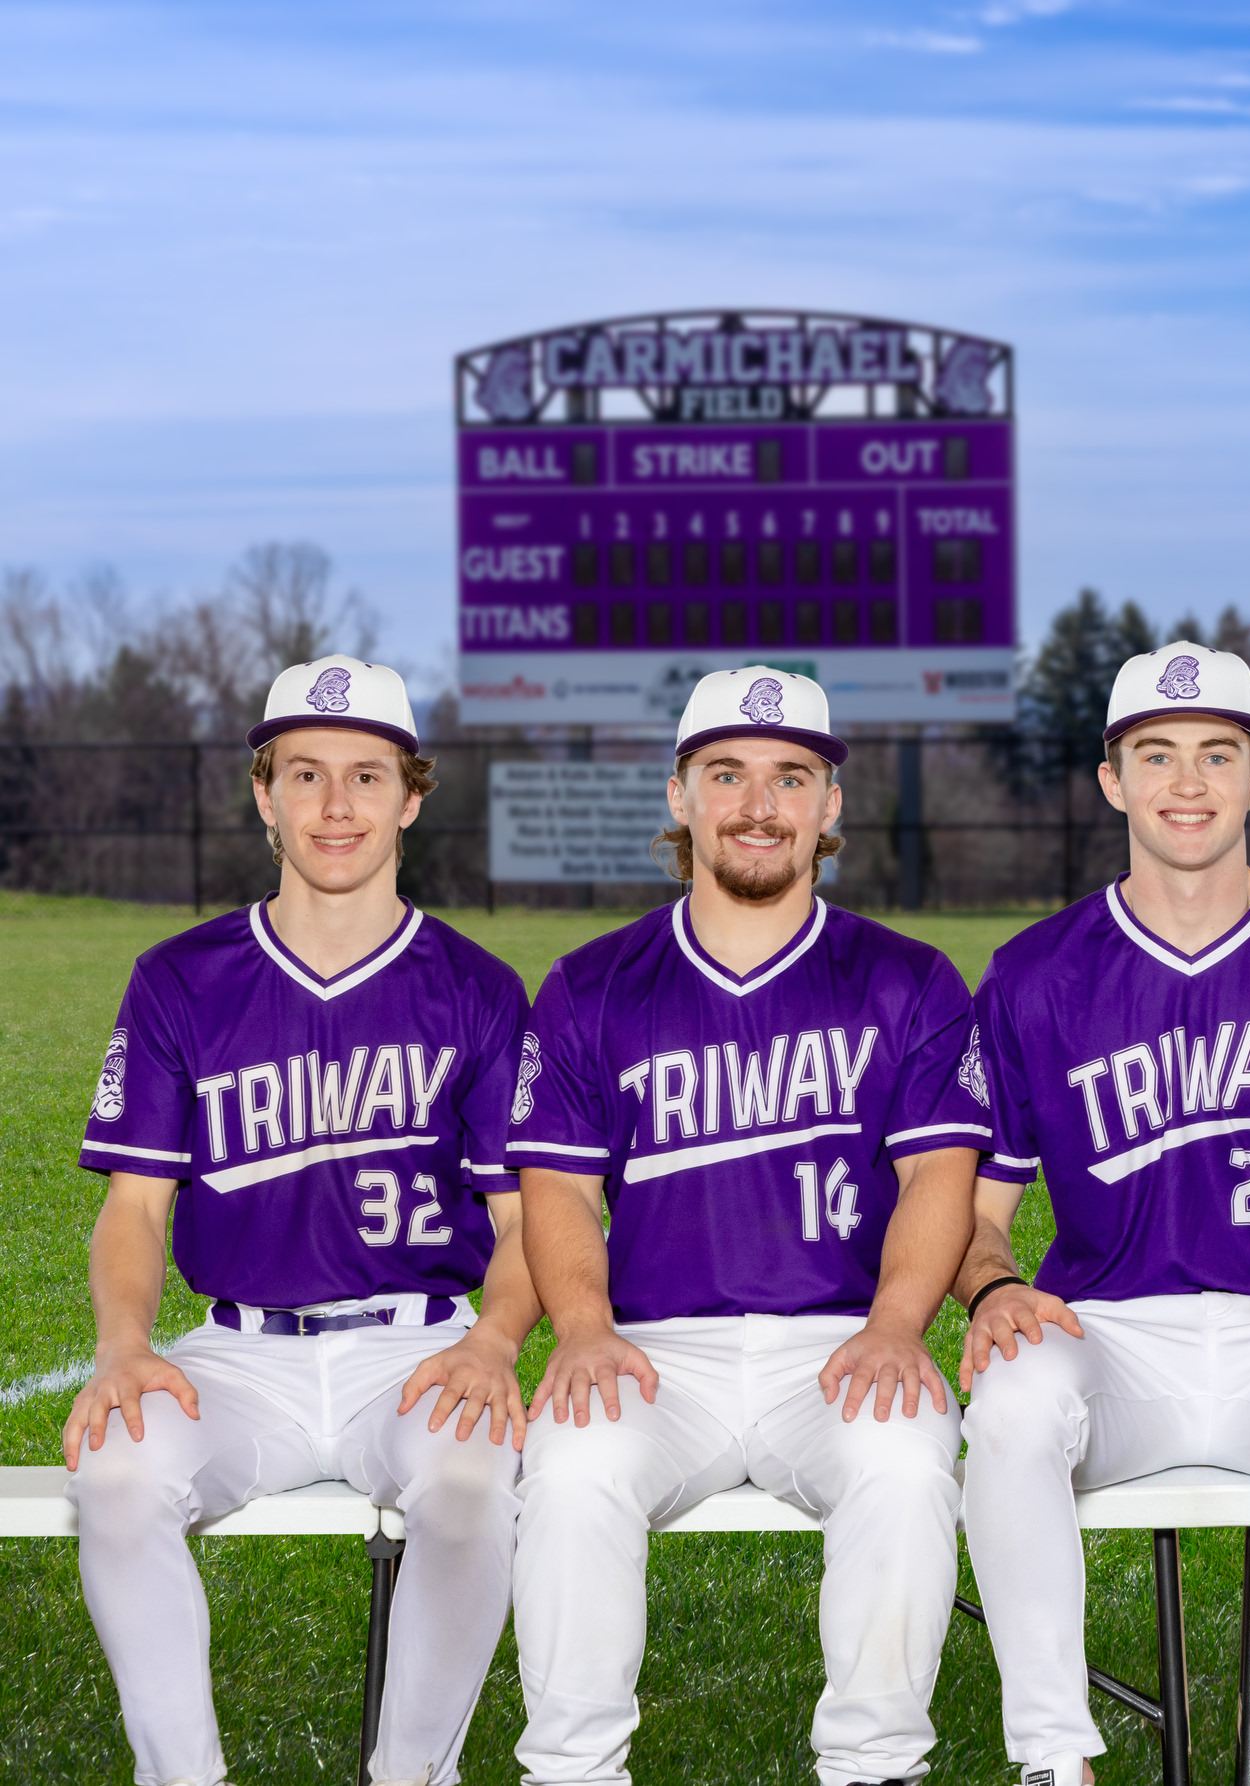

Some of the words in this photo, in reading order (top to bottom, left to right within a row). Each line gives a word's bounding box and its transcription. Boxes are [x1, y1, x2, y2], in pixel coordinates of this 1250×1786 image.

[546, 330, 917, 384] CARMICHAEL
[681, 388, 784, 419] FIELD
[479, 448, 563, 477] BALL
[634, 443, 750, 476] STRIKE
[861, 441, 939, 472] OUT
[580, 513, 590, 538] 1
[616, 513, 629, 538] 2
[654, 513, 667, 537] 3
[690, 513, 703, 537] 4
[727, 512, 739, 536] 5
[764, 512, 777, 536] 6
[803, 511, 815, 535] 7
[840, 511, 852, 535] 8
[877, 510, 889, 535] 9
[918, 509, 996, 534] TOTAL
[463, 548, 563, 581] GUEST
[463, 606, 568, 640] TITANS
[196, 1044, 456, 1163] TRIWAY
[619, 1027, 878, 1149] TRIWAY
[355, 1170, 453, 1246] 32
[794, 1157, 862, 1241] 14
